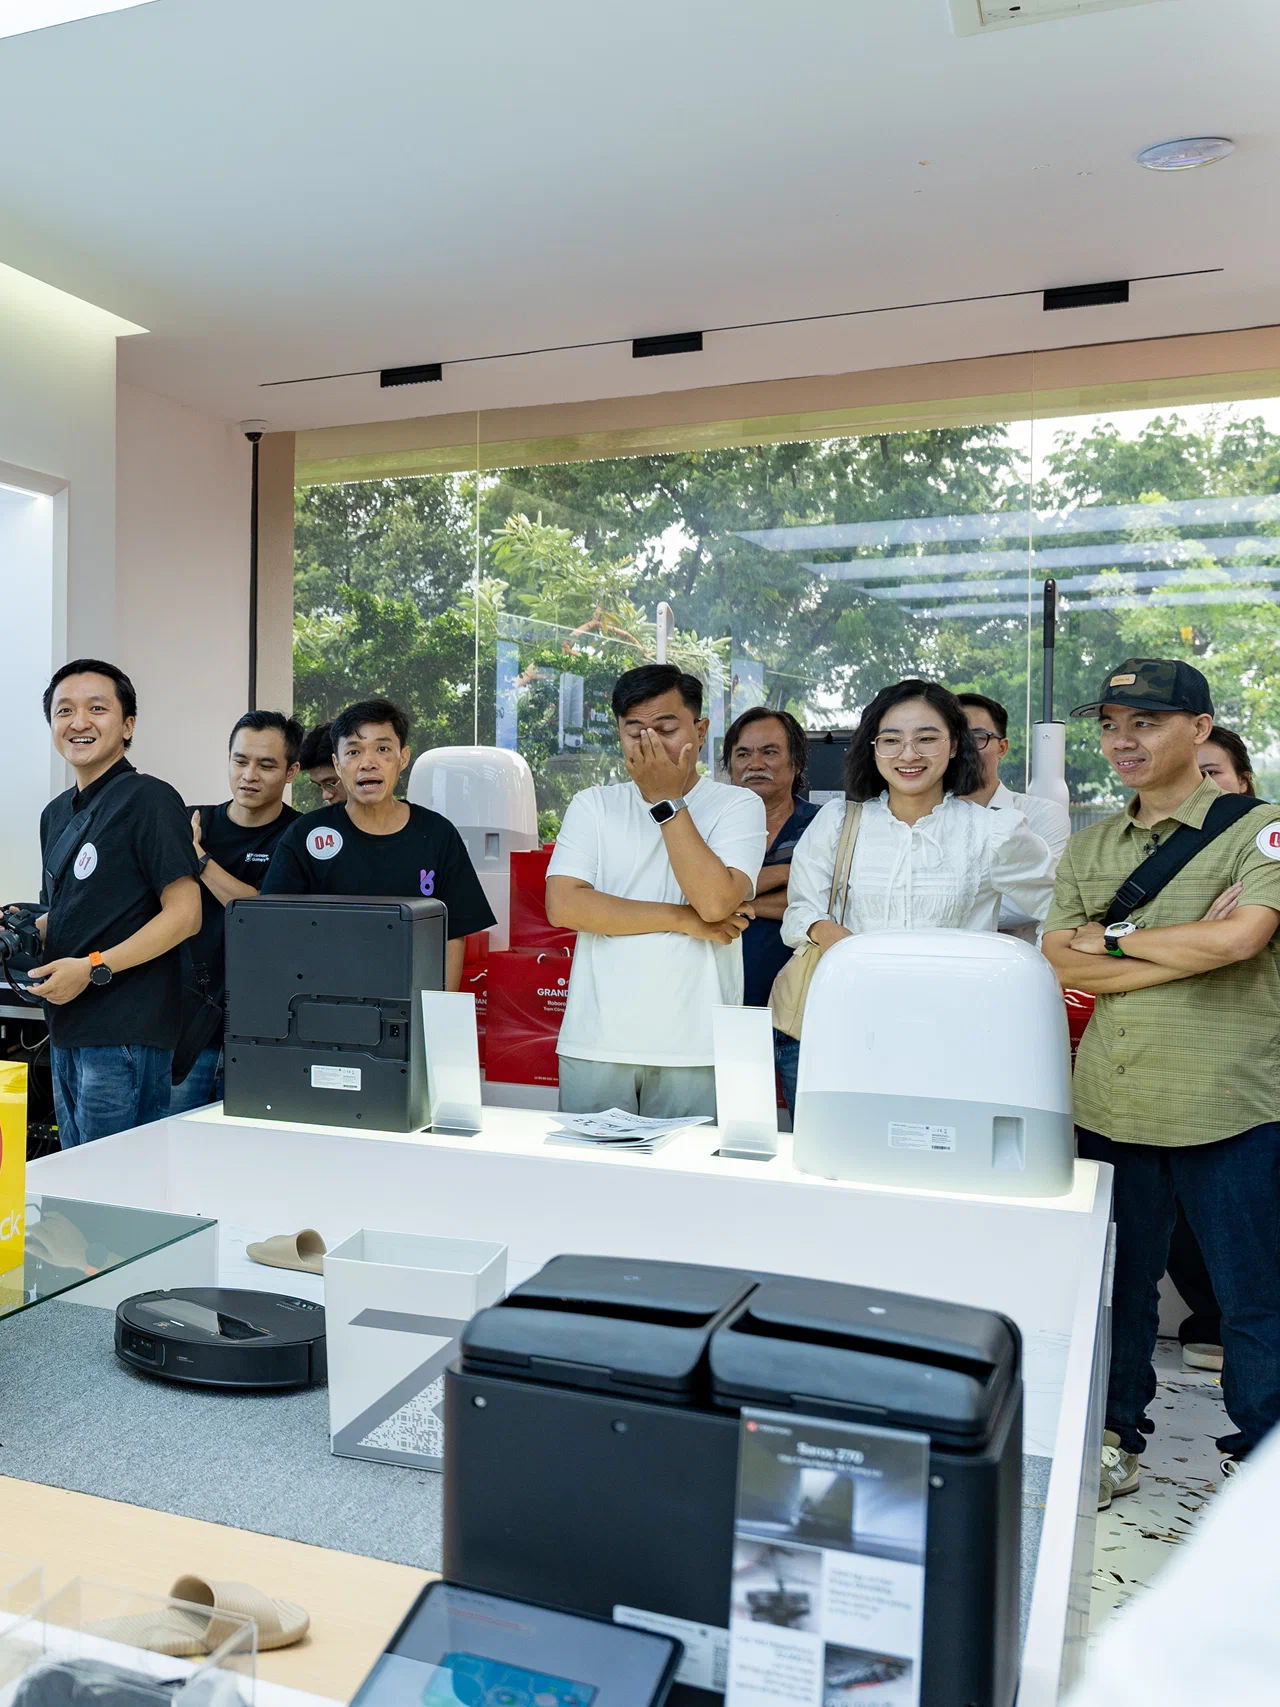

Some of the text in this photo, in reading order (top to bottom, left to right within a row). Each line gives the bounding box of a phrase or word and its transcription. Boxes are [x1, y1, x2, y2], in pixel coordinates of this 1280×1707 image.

[314, 834, 335, 850] 04
[1269, 831, 1280, 848] 0
[78, 851, 92, 871] 31
[796, 1440, 835, 1461] Saros
